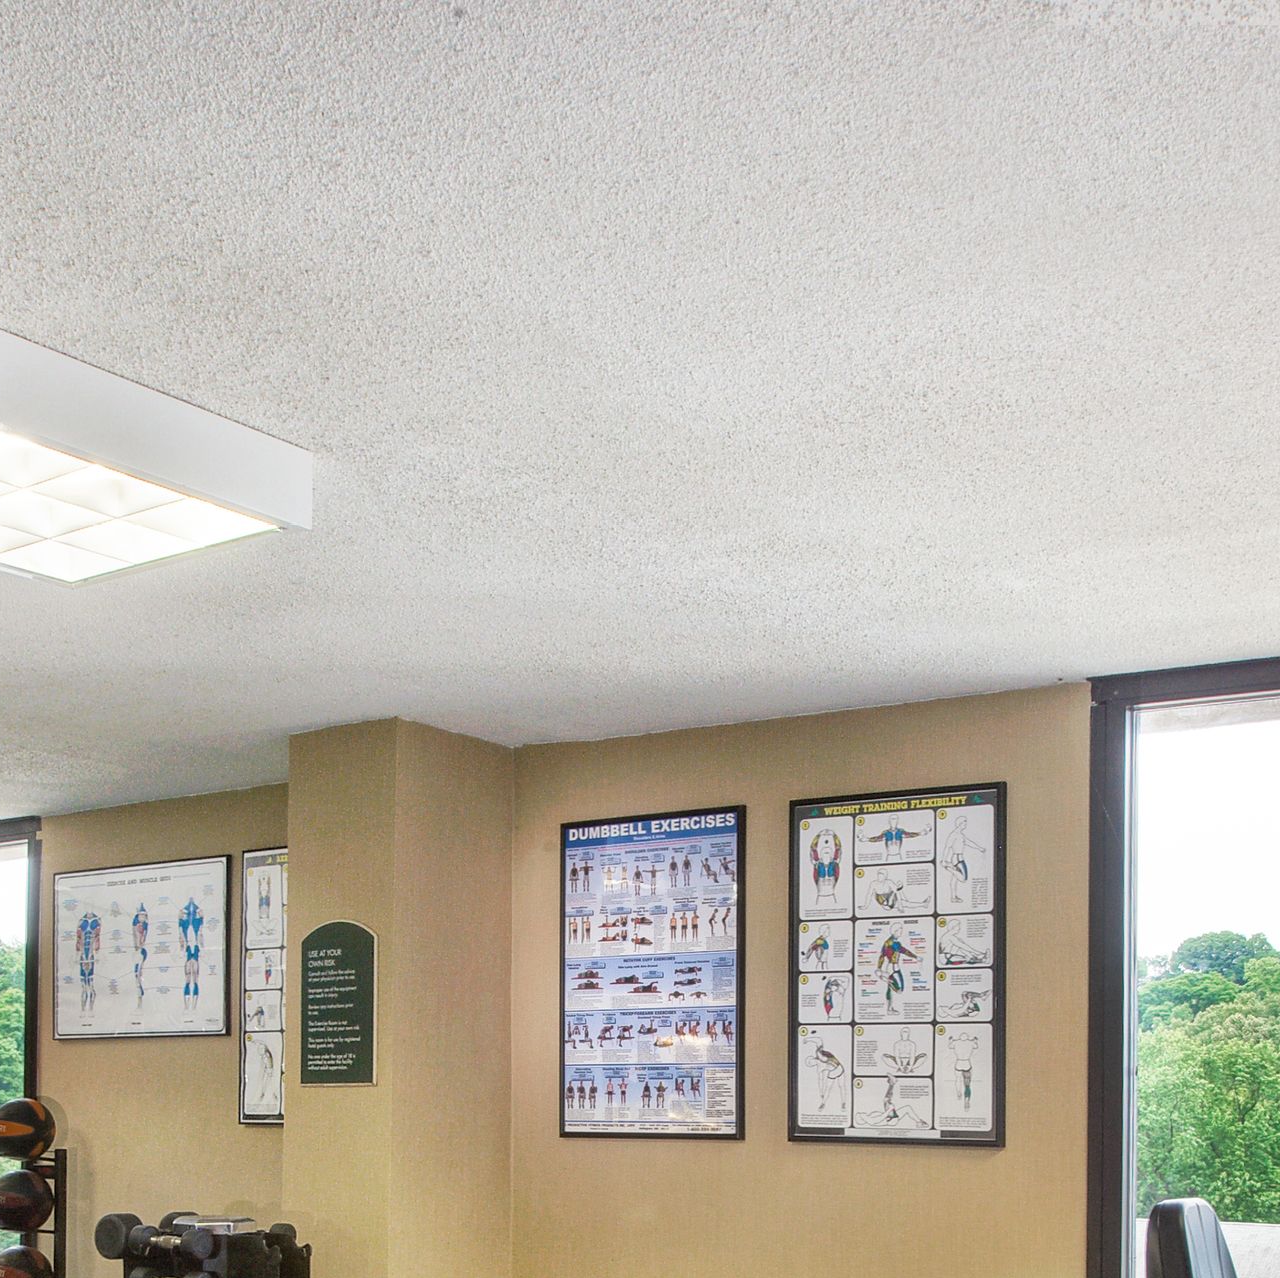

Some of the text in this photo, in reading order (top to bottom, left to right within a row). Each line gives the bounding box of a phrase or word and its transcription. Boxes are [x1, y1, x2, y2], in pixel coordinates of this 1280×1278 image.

[824, 796, 967, 815] WEIGHT TRAINING FLEXIBILITY
[569, 813, 736, 842] DUMBBELL EXERCISES
[308, 948, 342, 958] USE AT YOUR
[308, 959, 336, 968] OWN RISK
